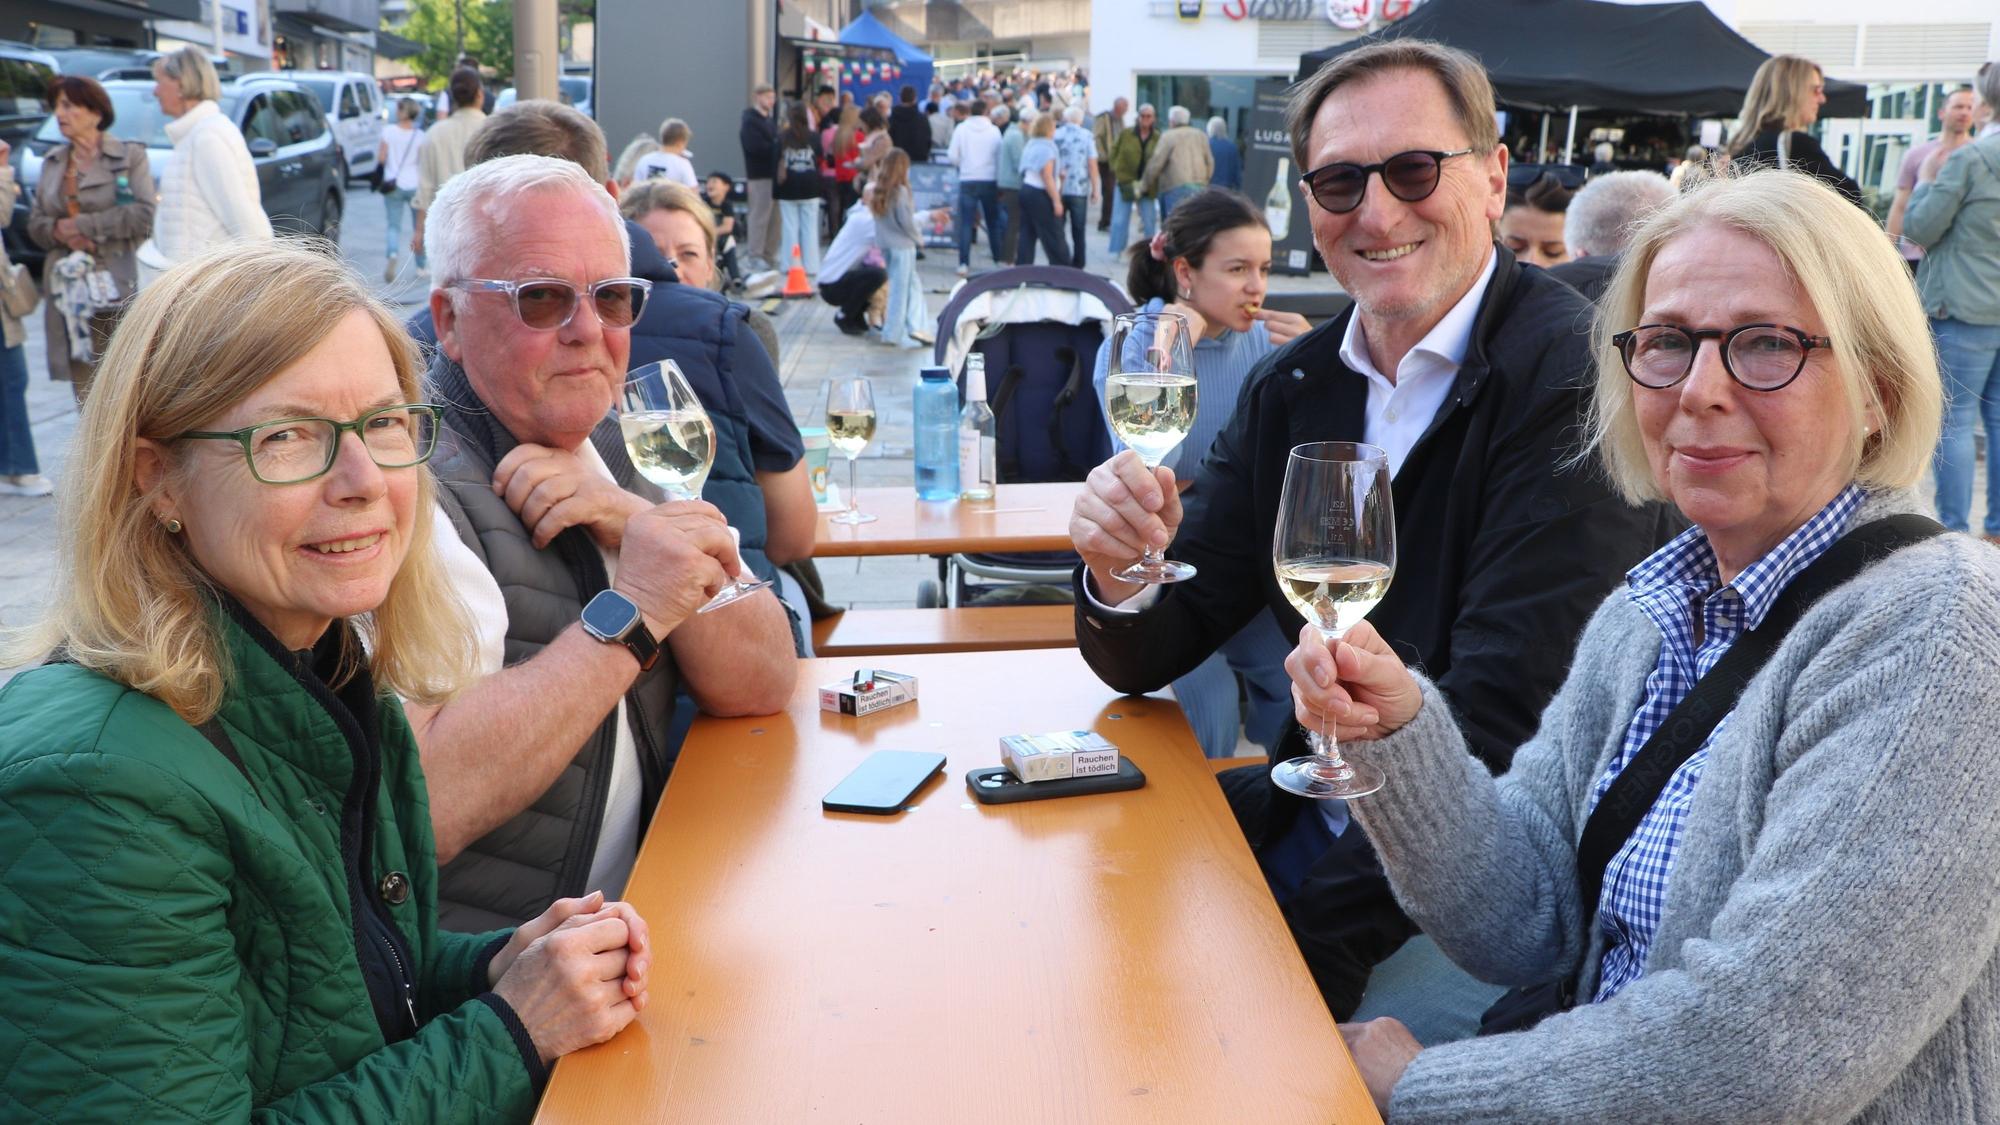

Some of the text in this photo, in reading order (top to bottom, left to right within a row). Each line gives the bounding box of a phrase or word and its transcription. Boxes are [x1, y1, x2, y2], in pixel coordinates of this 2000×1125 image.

[860, 690, 889, 703] Rauchen
[868, 697, 890, 710] tödlich
[1078, 754, 1114, 764] Rauchen
[1076, 763, 1116, 774] ist tödlich
